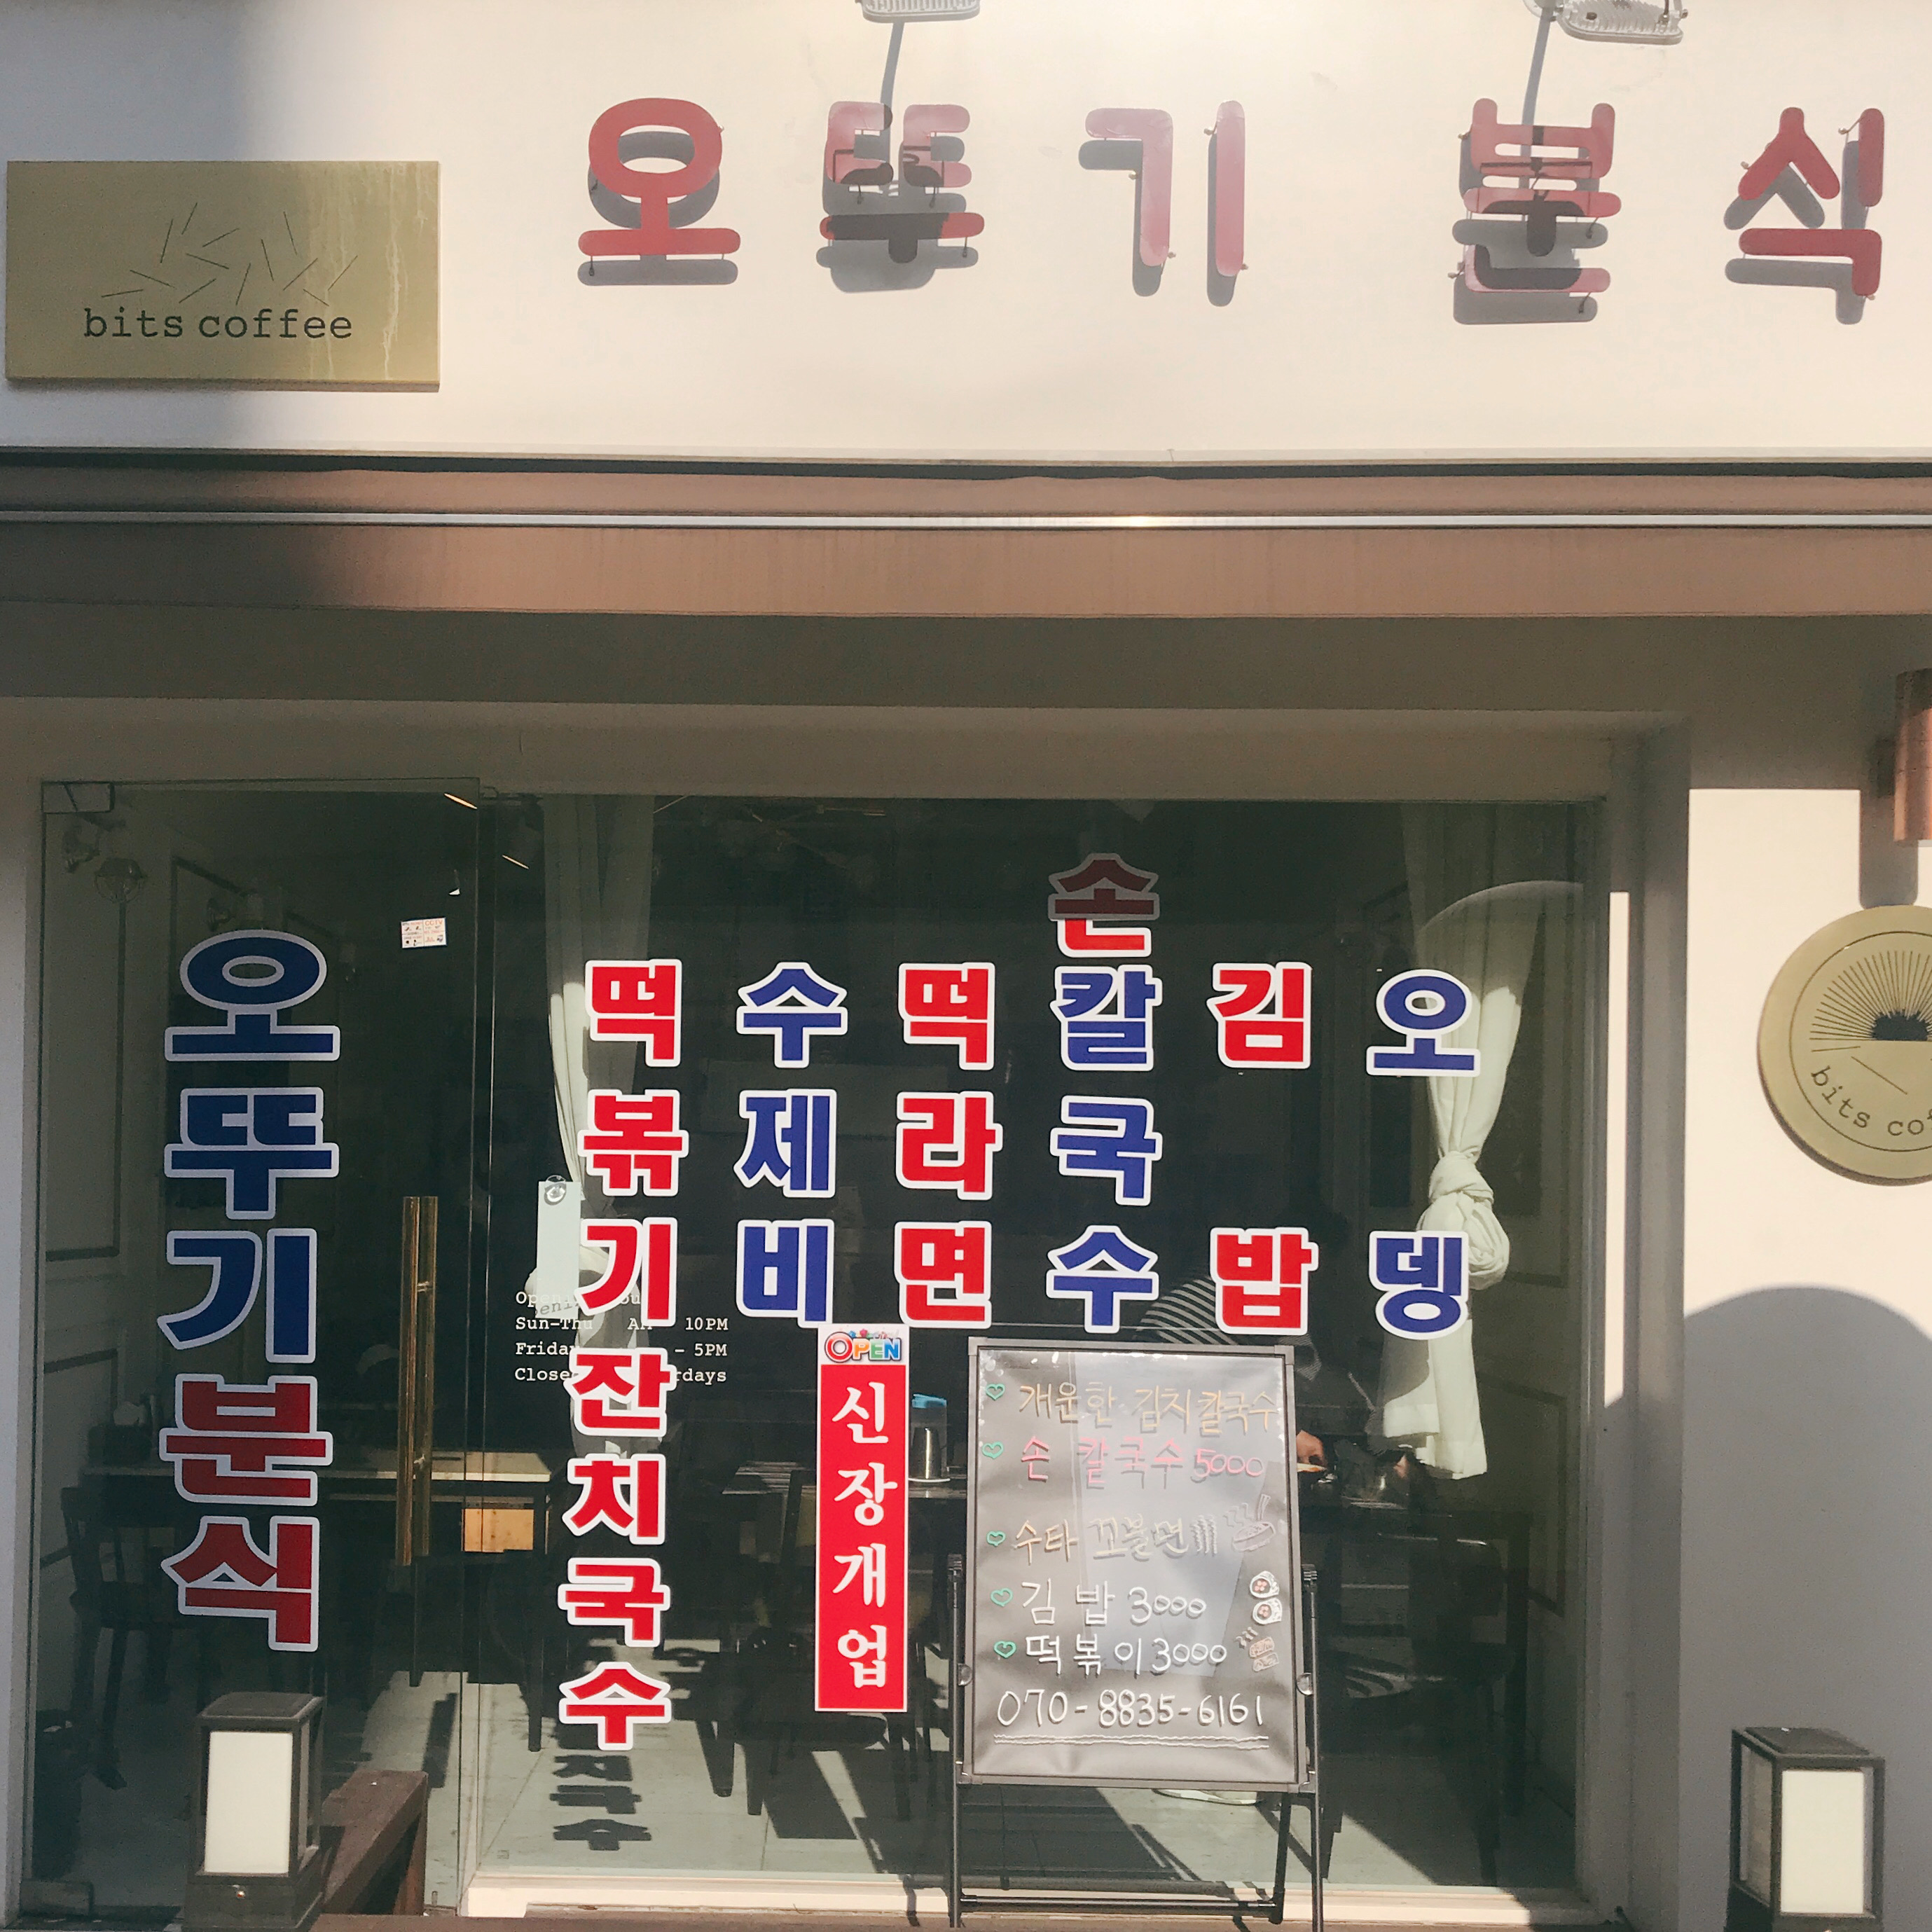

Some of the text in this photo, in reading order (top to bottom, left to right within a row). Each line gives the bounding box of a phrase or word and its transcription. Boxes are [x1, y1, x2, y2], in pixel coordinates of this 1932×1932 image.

[578, 98, 1884, 296] 오뚜기 분식
[83, 308, 354, 339] bits coffee
[1047, 853, 1163, 1334] 손칼국수
[1812, 1065, 1870, 1129] bits
[575, 959, 689, 1327] 떡볶기
[733, 962, 848, 1328] 수제비
[894, 962, 1004, 1329] 떡라면
[158, 930, 340, 1652] 오뚜기 분식
[516, 1316, 593, 1330] Sun-Thu
[685, 1316, 729, 1331] 10PM
[694, 1343, 728, 1357] 5PM
[824, 1332, 902, 1363] OPEN
[1019, 1381, 1117, 1423] 개운한
[1194, 1447, 1264, 1478] 5000
[558, 1348, 677, 1751] 잔치국수
[832, 1381, 898, 1689] 신장개업
[1015, 1519, 1079, 1564] 수타
[1129, 1586, 1207, 1624] 3000
[1151, 1637, 1227, 1674] 3000
[997, 1689, 1264, 1727] 070-8835-6161
